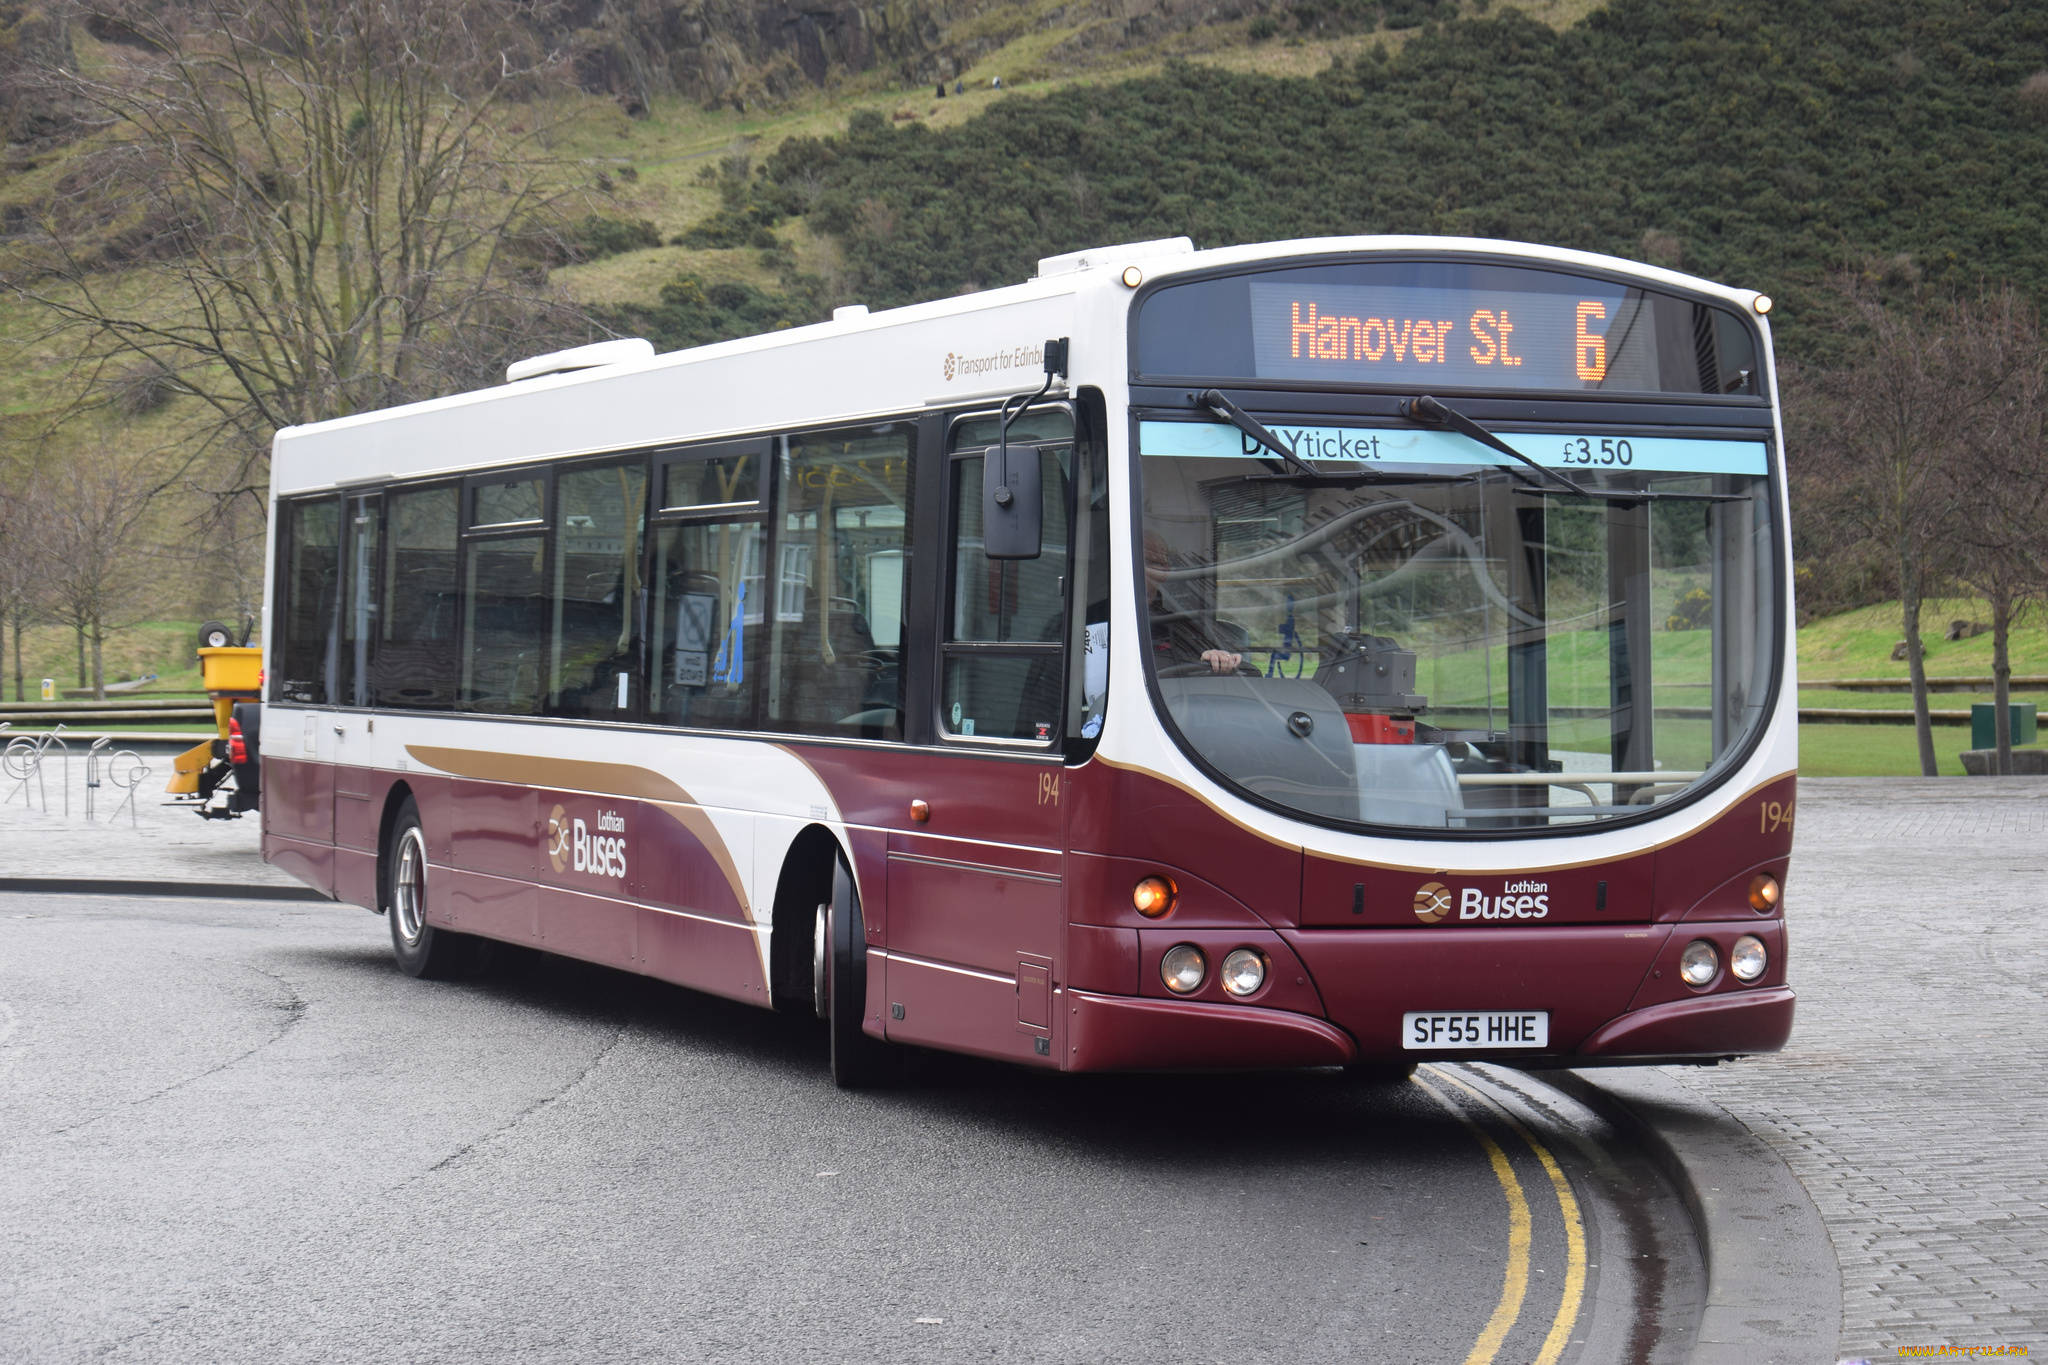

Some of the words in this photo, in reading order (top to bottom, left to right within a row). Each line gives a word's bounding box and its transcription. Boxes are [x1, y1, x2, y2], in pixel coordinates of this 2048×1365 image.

[1291, 301, 1453, 364] Hanover
[1469, 309, 1522, 367] St.
[1575, 301, 1606, 382] 6
[957, 353, 999, 377] Transport
[1000, 350, 1014, 369] for
[1014, 345, 1045, 368] Edinbu
[1563, 437, 1633, 466] £3.50
[1038, 772, 1060, 807] 194
[597, 809, 625, 833] Lothian
[1760, 800, 1794, 834] 194
[573, 818, 627, 878] Buses
[1504, 880, 1548, 894] Lothian
[1459, 888, 1549, 920] Buses
[1414, 1017, 1480, 1043] SF55
[1488, 1016, 1536, 1042] HHE
